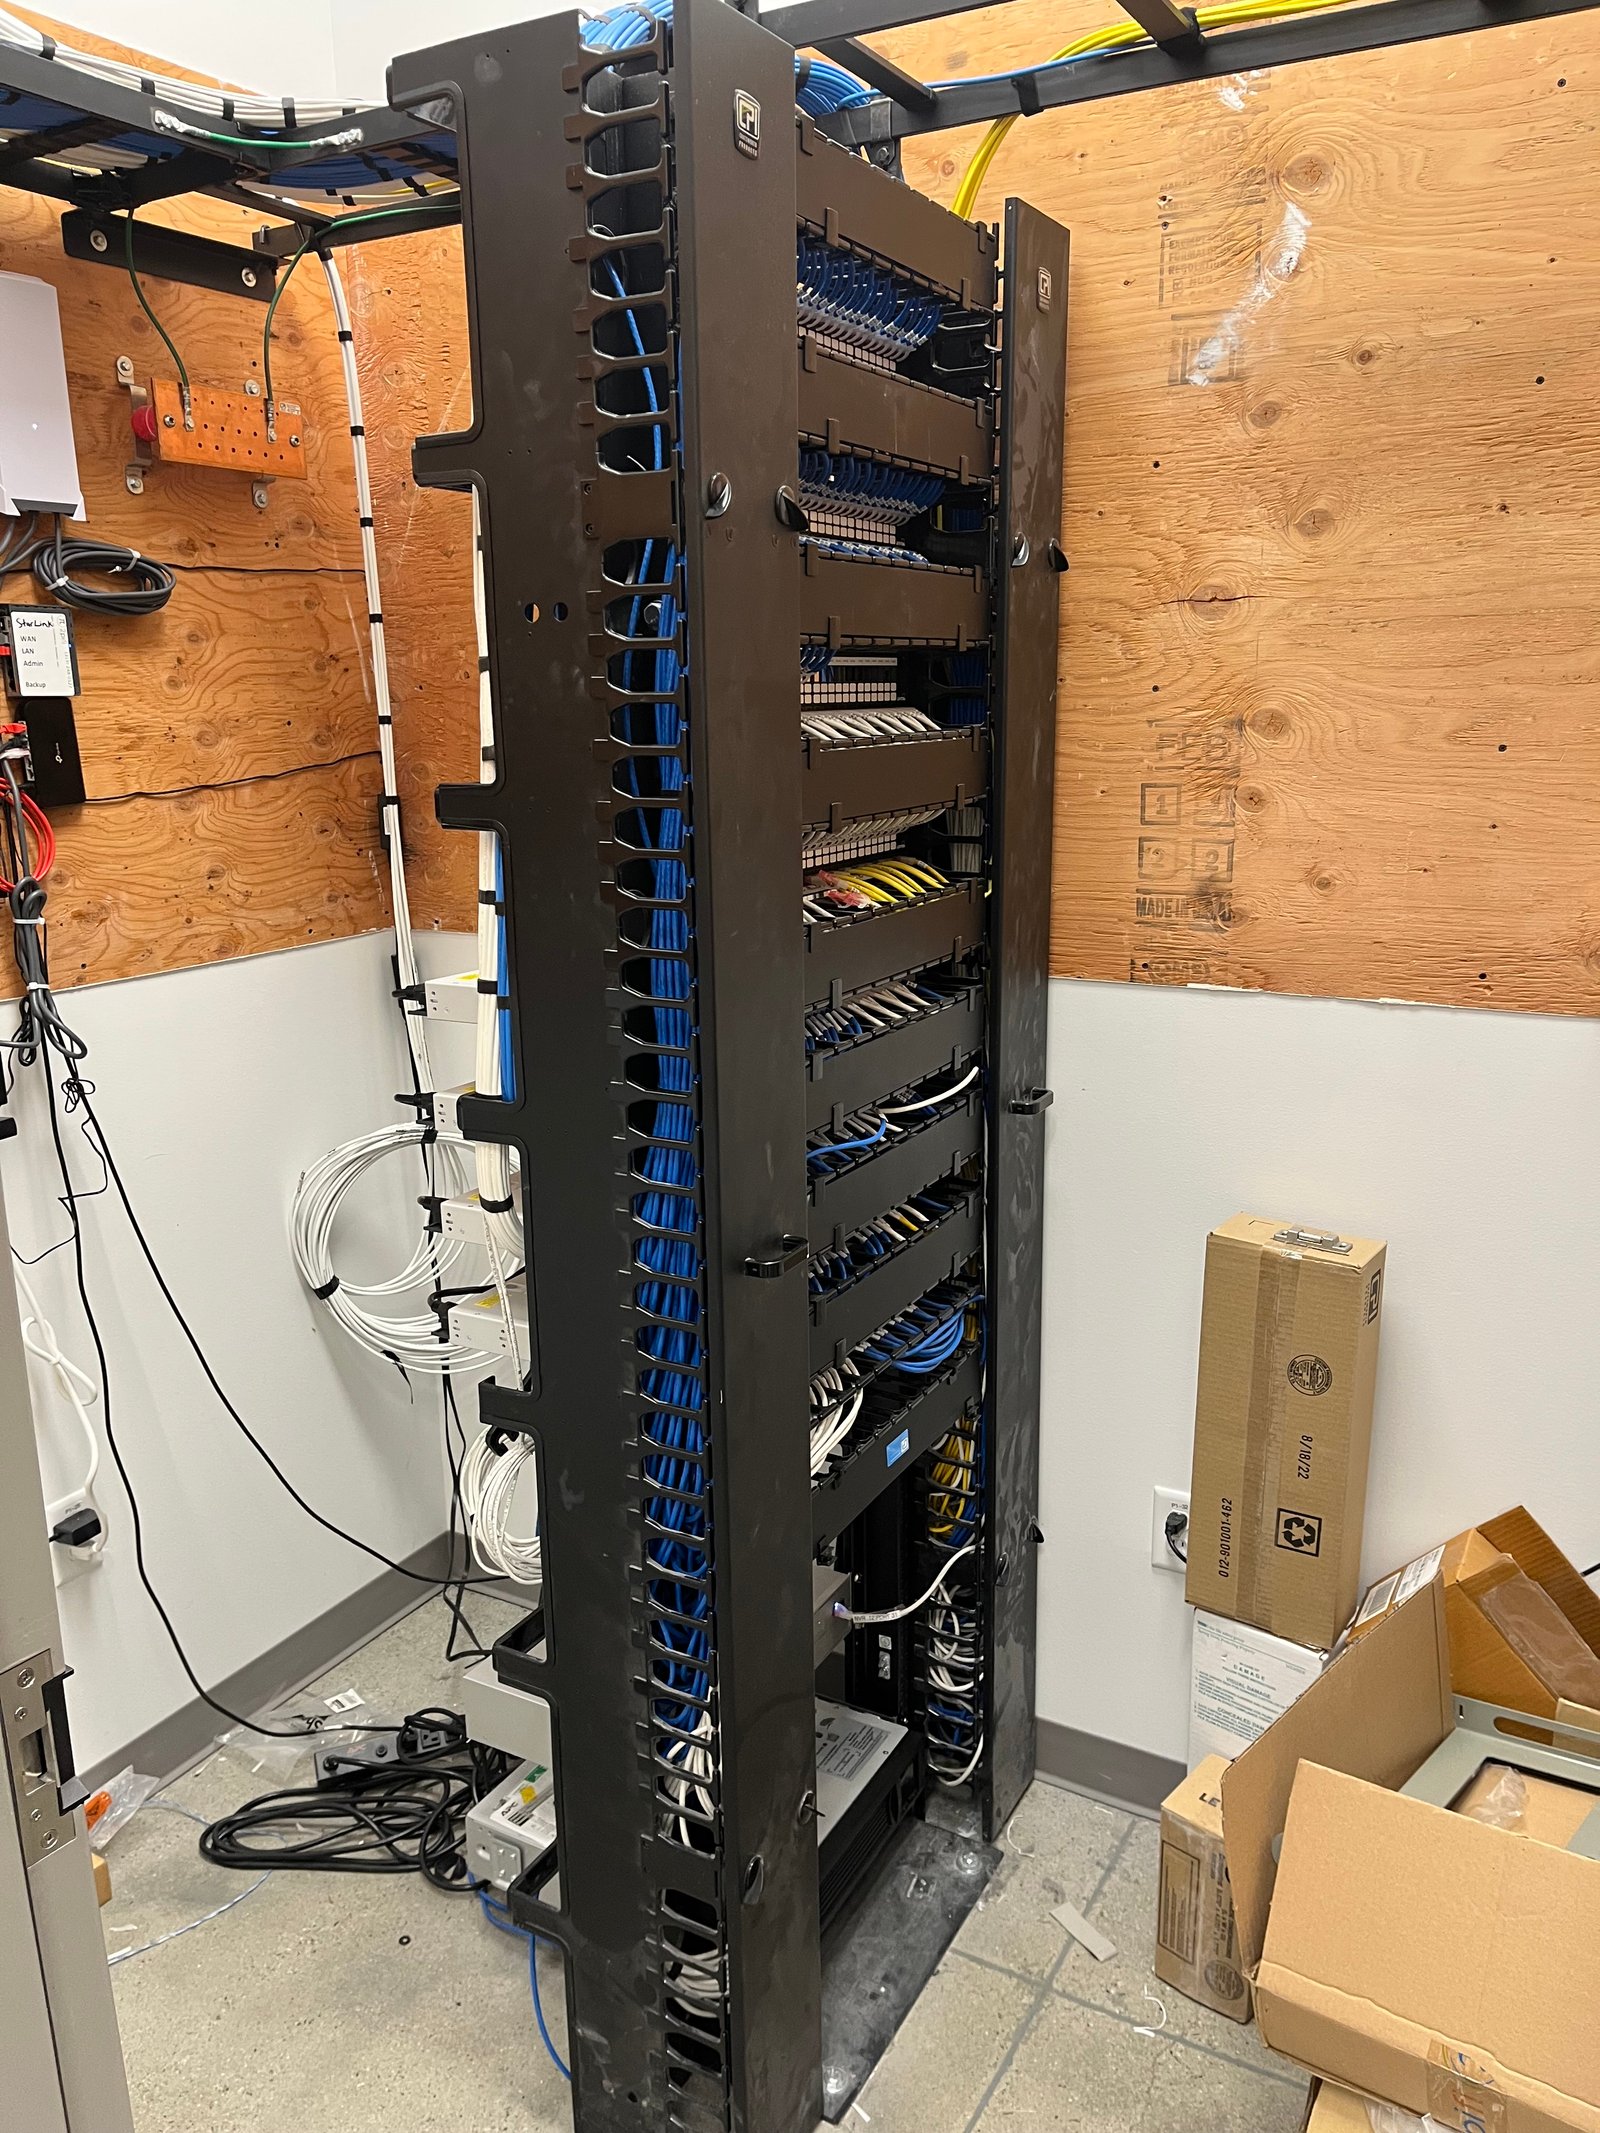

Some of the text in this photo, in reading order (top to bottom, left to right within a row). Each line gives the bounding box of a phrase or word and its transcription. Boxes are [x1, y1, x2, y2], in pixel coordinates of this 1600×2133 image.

[1136, 897, 1173, 918] MADE
[1297, 1434, 1313, 1480] 8/18/22
[1218, 1497, 1232, 1578] 012-901001-462
